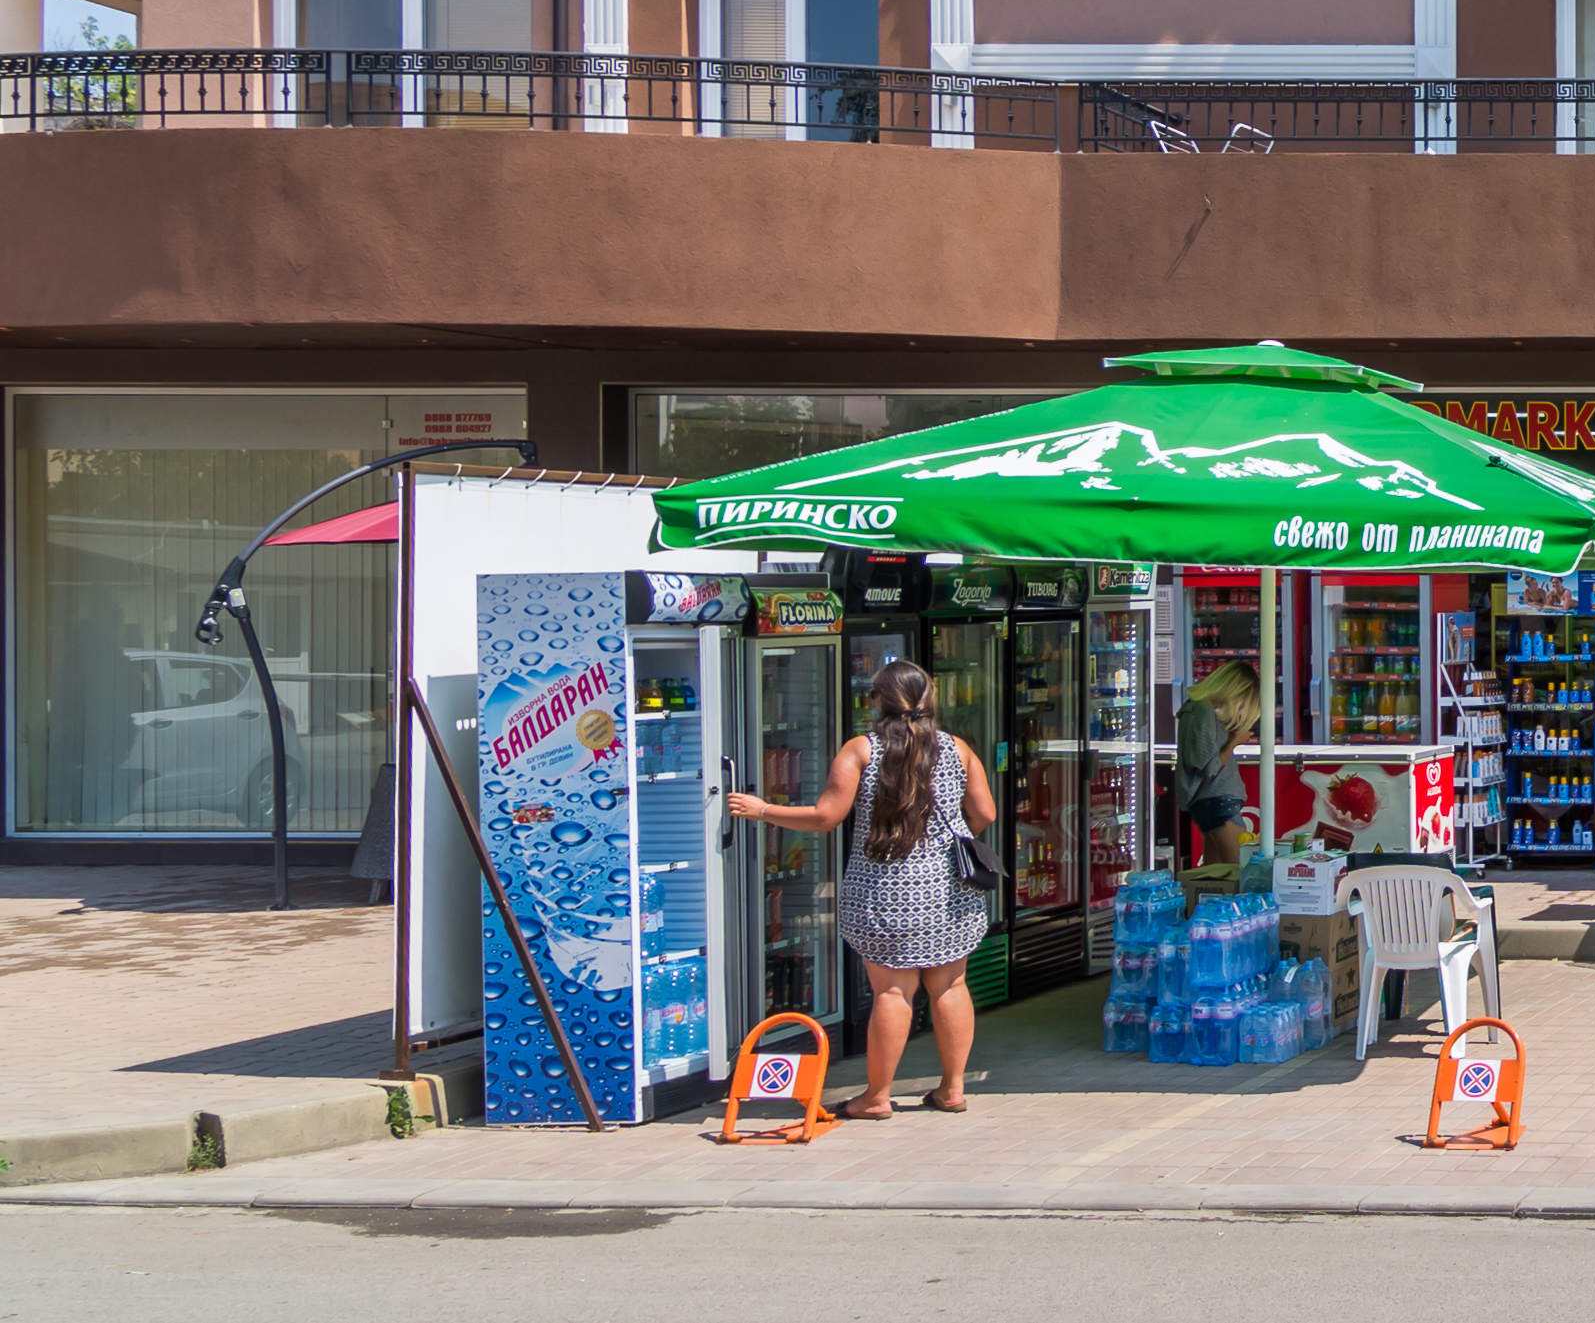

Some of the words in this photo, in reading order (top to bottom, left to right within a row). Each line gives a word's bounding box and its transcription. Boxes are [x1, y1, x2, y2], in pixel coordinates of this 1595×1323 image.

[698, 501, 898, 530] ПИРИНСКО
[1274, 515, 1348, 551] свежо
[1361, 523, 1398, 553] от
[1409, 522, 1544, 554] планината
[1027, 582, 1058, 598] TUBORG
[780, 605, 835, 623] FLORINA
[507, 693, 547, 726] ИЗВОРНА
[547, 674, 572, 696] ВОДА
[493, 662, 610, 769] БАЛДАРАН
[526, 744, 573, 765] БУТИЛИРАНА
[549, 752, 574, 767] ДЕВИН
